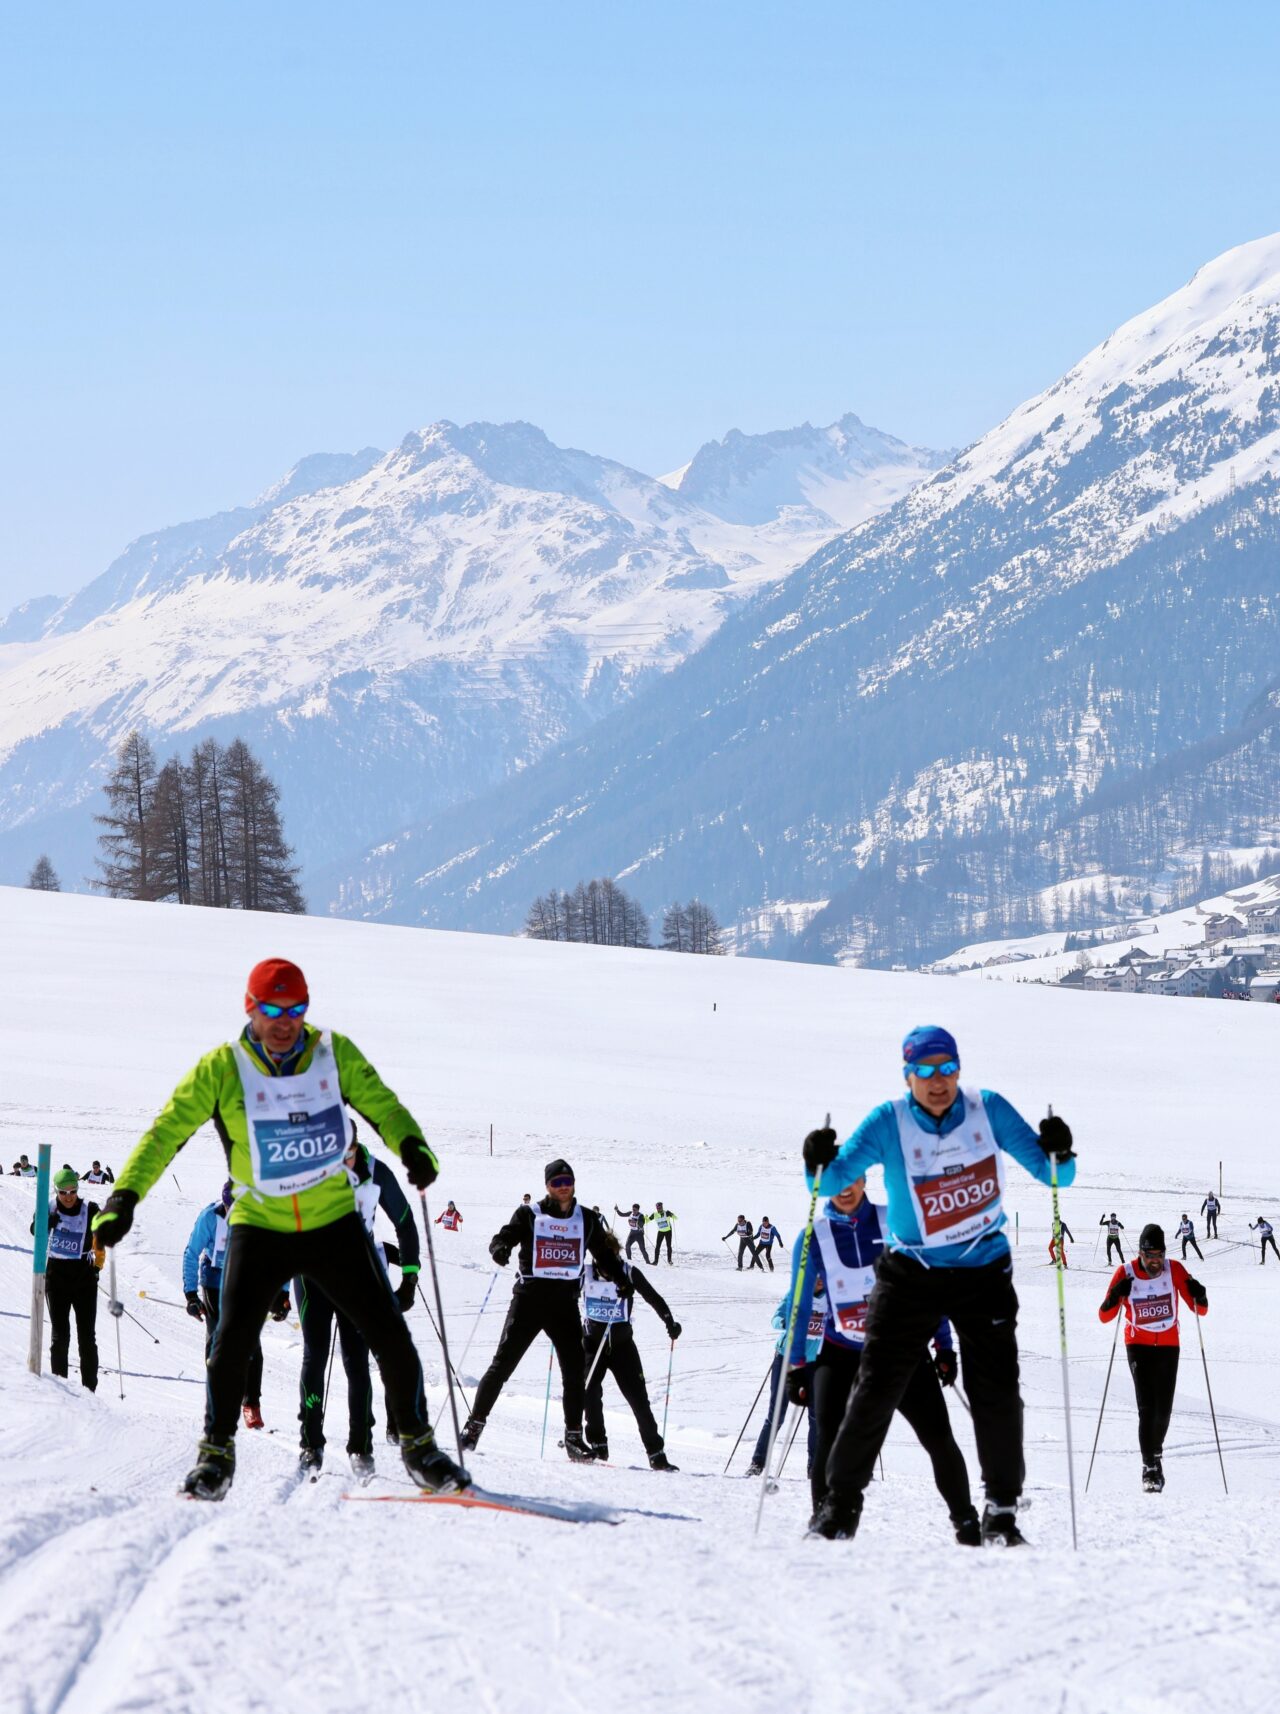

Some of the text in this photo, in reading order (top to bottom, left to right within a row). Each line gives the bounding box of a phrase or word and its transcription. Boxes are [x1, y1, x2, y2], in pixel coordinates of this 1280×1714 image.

[267, 1133, 338, 1163] 26012
[946, 1166, 962, 1176] G20
[924, 1179, 995, 1217] 20030
[549, 1223, 568, 1233] coop
[945, 1222, 982, 1242] helvetia
[540, 1248, 576, 1261] 18094
[588, 1308, 622, 1317] 22305
[1139, 1305, 1169, 1317] 18098
